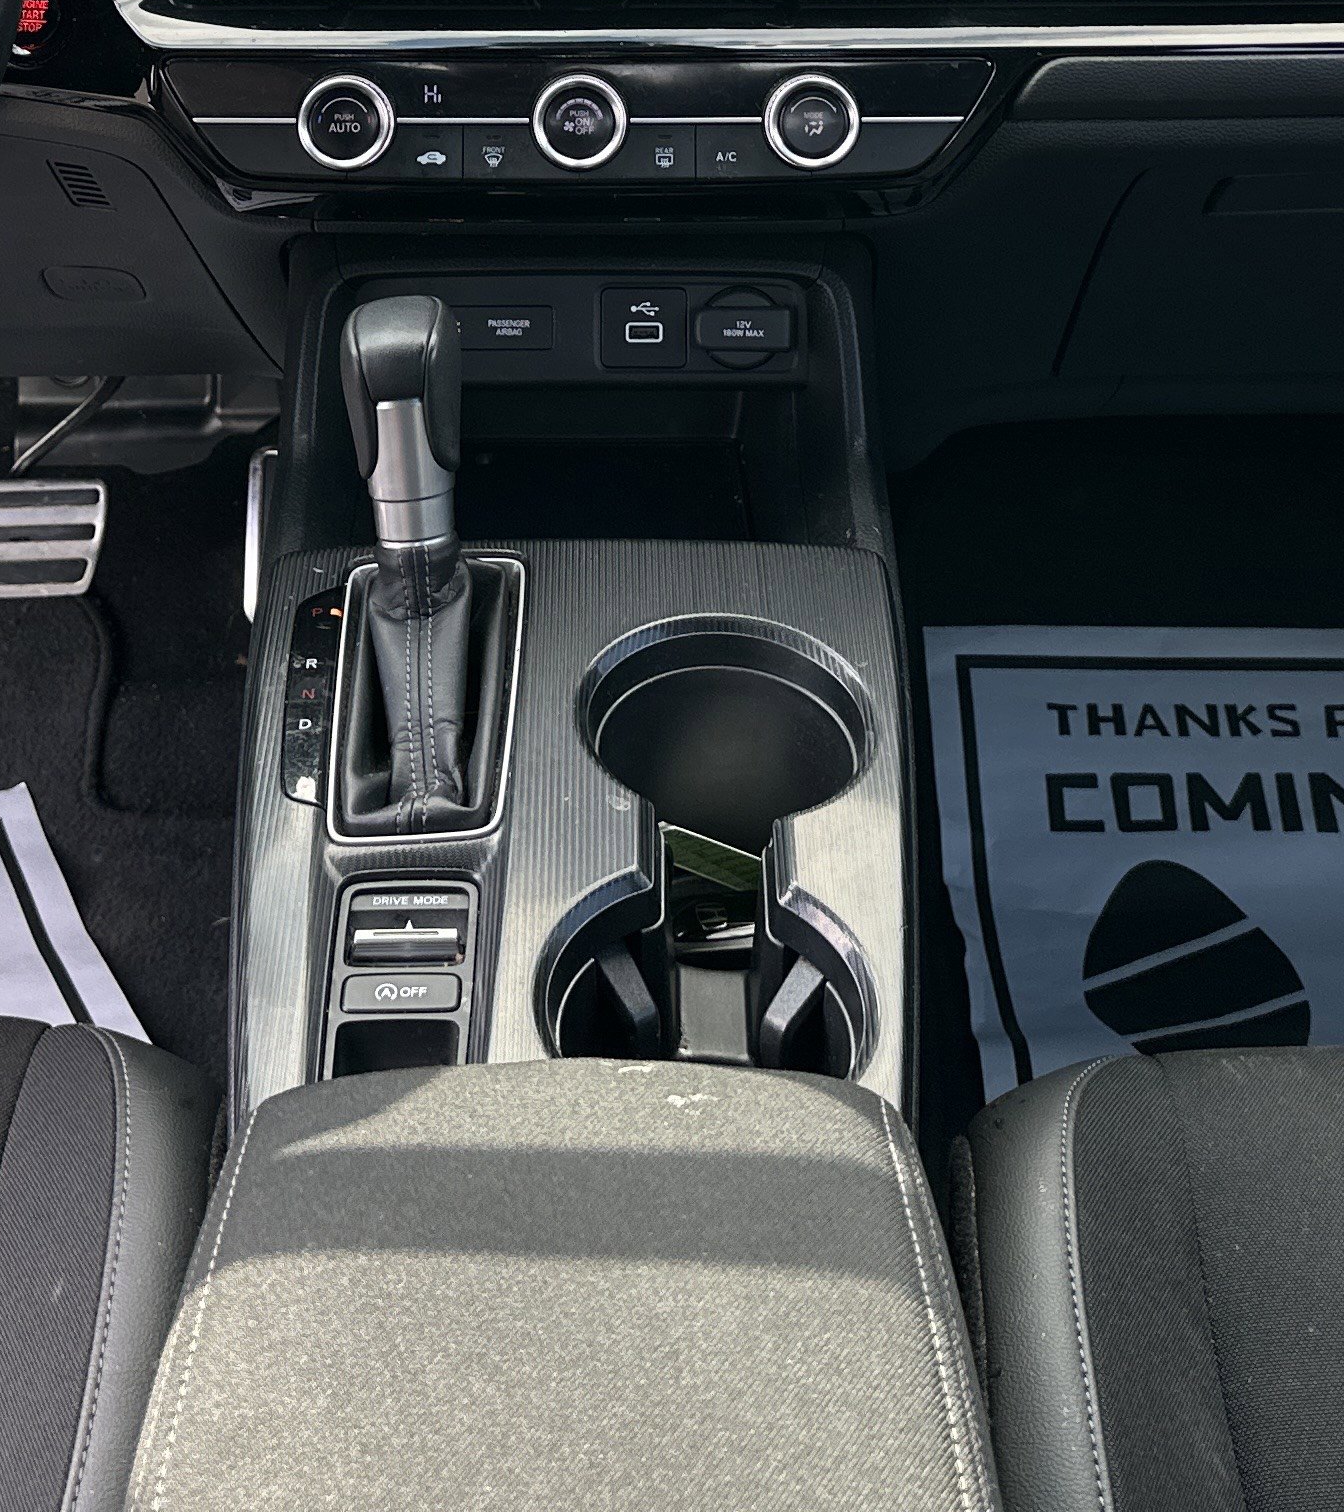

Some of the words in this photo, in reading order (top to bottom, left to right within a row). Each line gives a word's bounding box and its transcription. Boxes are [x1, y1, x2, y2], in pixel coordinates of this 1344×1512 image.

[21, 9, 45, 20] TART
[17, 22, 43, 33] STOP
[334, 113, 354, 121] PUSH
[569, 109, 589, 118] PUSH
[329, 122, 361, 133] AUTO
[482, 146, 505, 154] FRONT
[716, 151, 737, 162] A/C
[487, 319, 530, 328] PASSENGER
[736, 320, 752, 329] 12V
[495, 327, 523, 336] AIRBAG
[745, 329, 765, 337] MAX
[305, 658, 318, 669] R
[301, 688, 315, 699] N
[298, 718, 312, 730] D
[1046, 701, 1301, 740] THANKS
[372, 896, 409, 906] DRIVE
[413, 895, 449, 906] MODE
[400, 986, 428, 998] OFF
